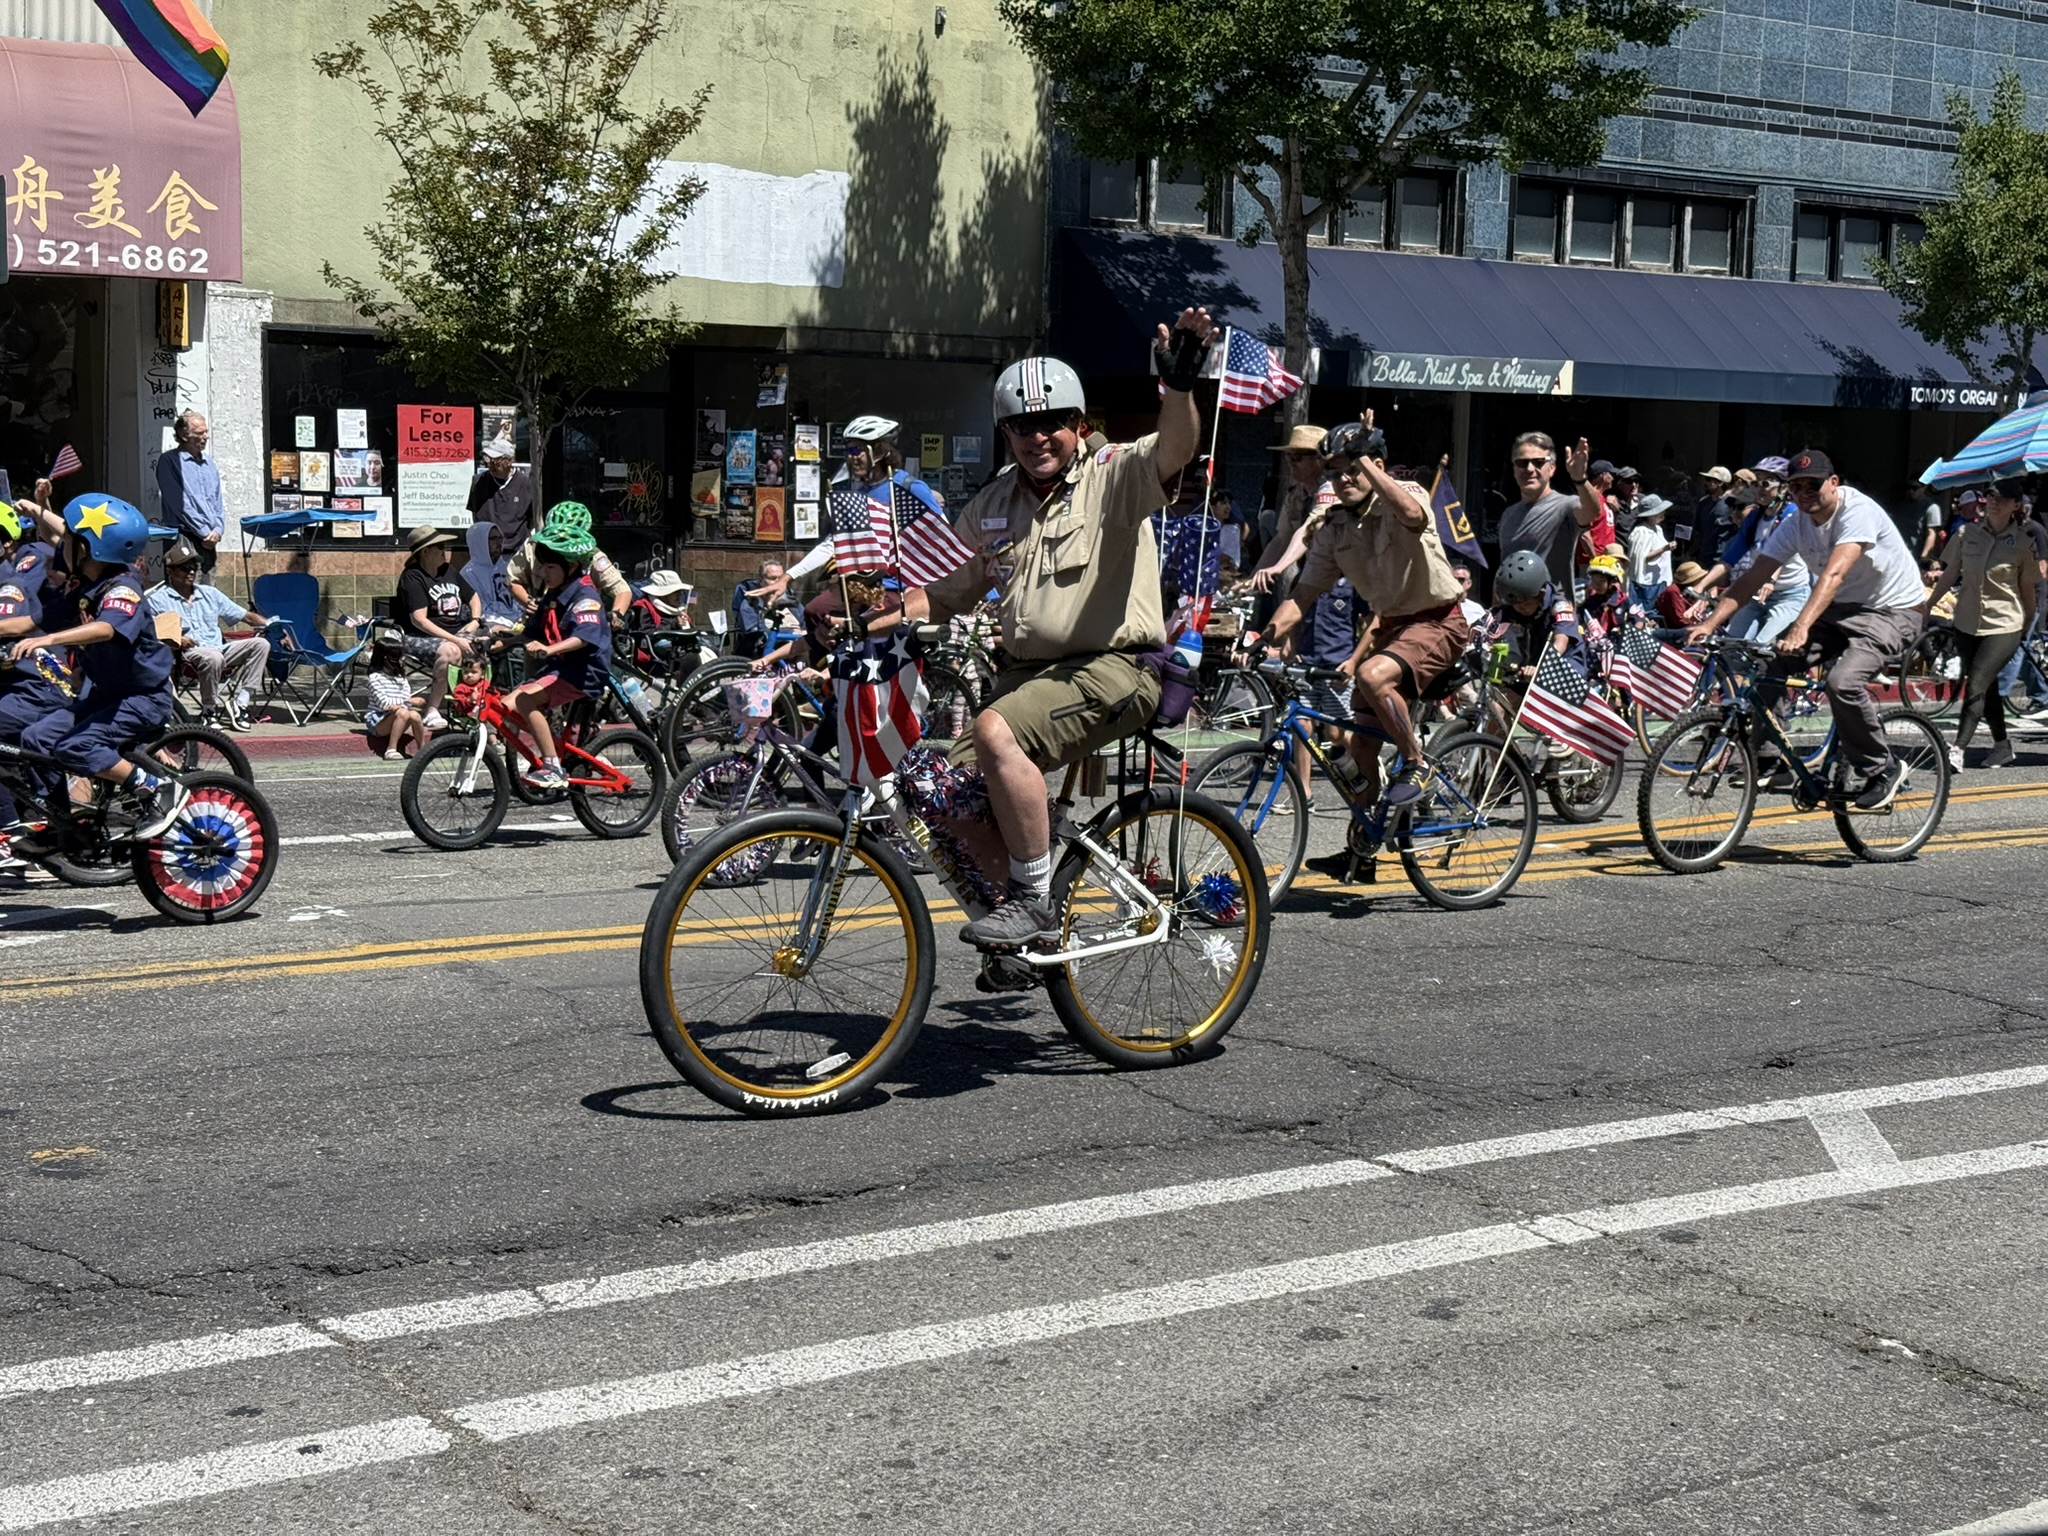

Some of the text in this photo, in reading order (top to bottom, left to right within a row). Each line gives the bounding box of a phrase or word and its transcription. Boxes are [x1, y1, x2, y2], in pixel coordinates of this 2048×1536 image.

[6, 154, 219, 241] 舟美食
[37, 239, 209, 274] 521-6862
[1372, 355, 1552, 393] Bella Nail Spa & Waxing
[1911, 387, 1956, 404] TOMO'S
[1959, 388, 2008, 406] ORGA
[420, 408, 453, 425] For
[408, 426, 464, 443] Lease
[924, 437, 940, 445] IMP
[403, 446, 471, 459] 415.395.7262
[402, 470, 450, 480] Justin Choi
[402, 492, 418, 500] Jeff
[108, 600, 133, 613] 1015
[905, 816, 930, 848] BIG
[742, 1089, 839, 1110] thickslick
